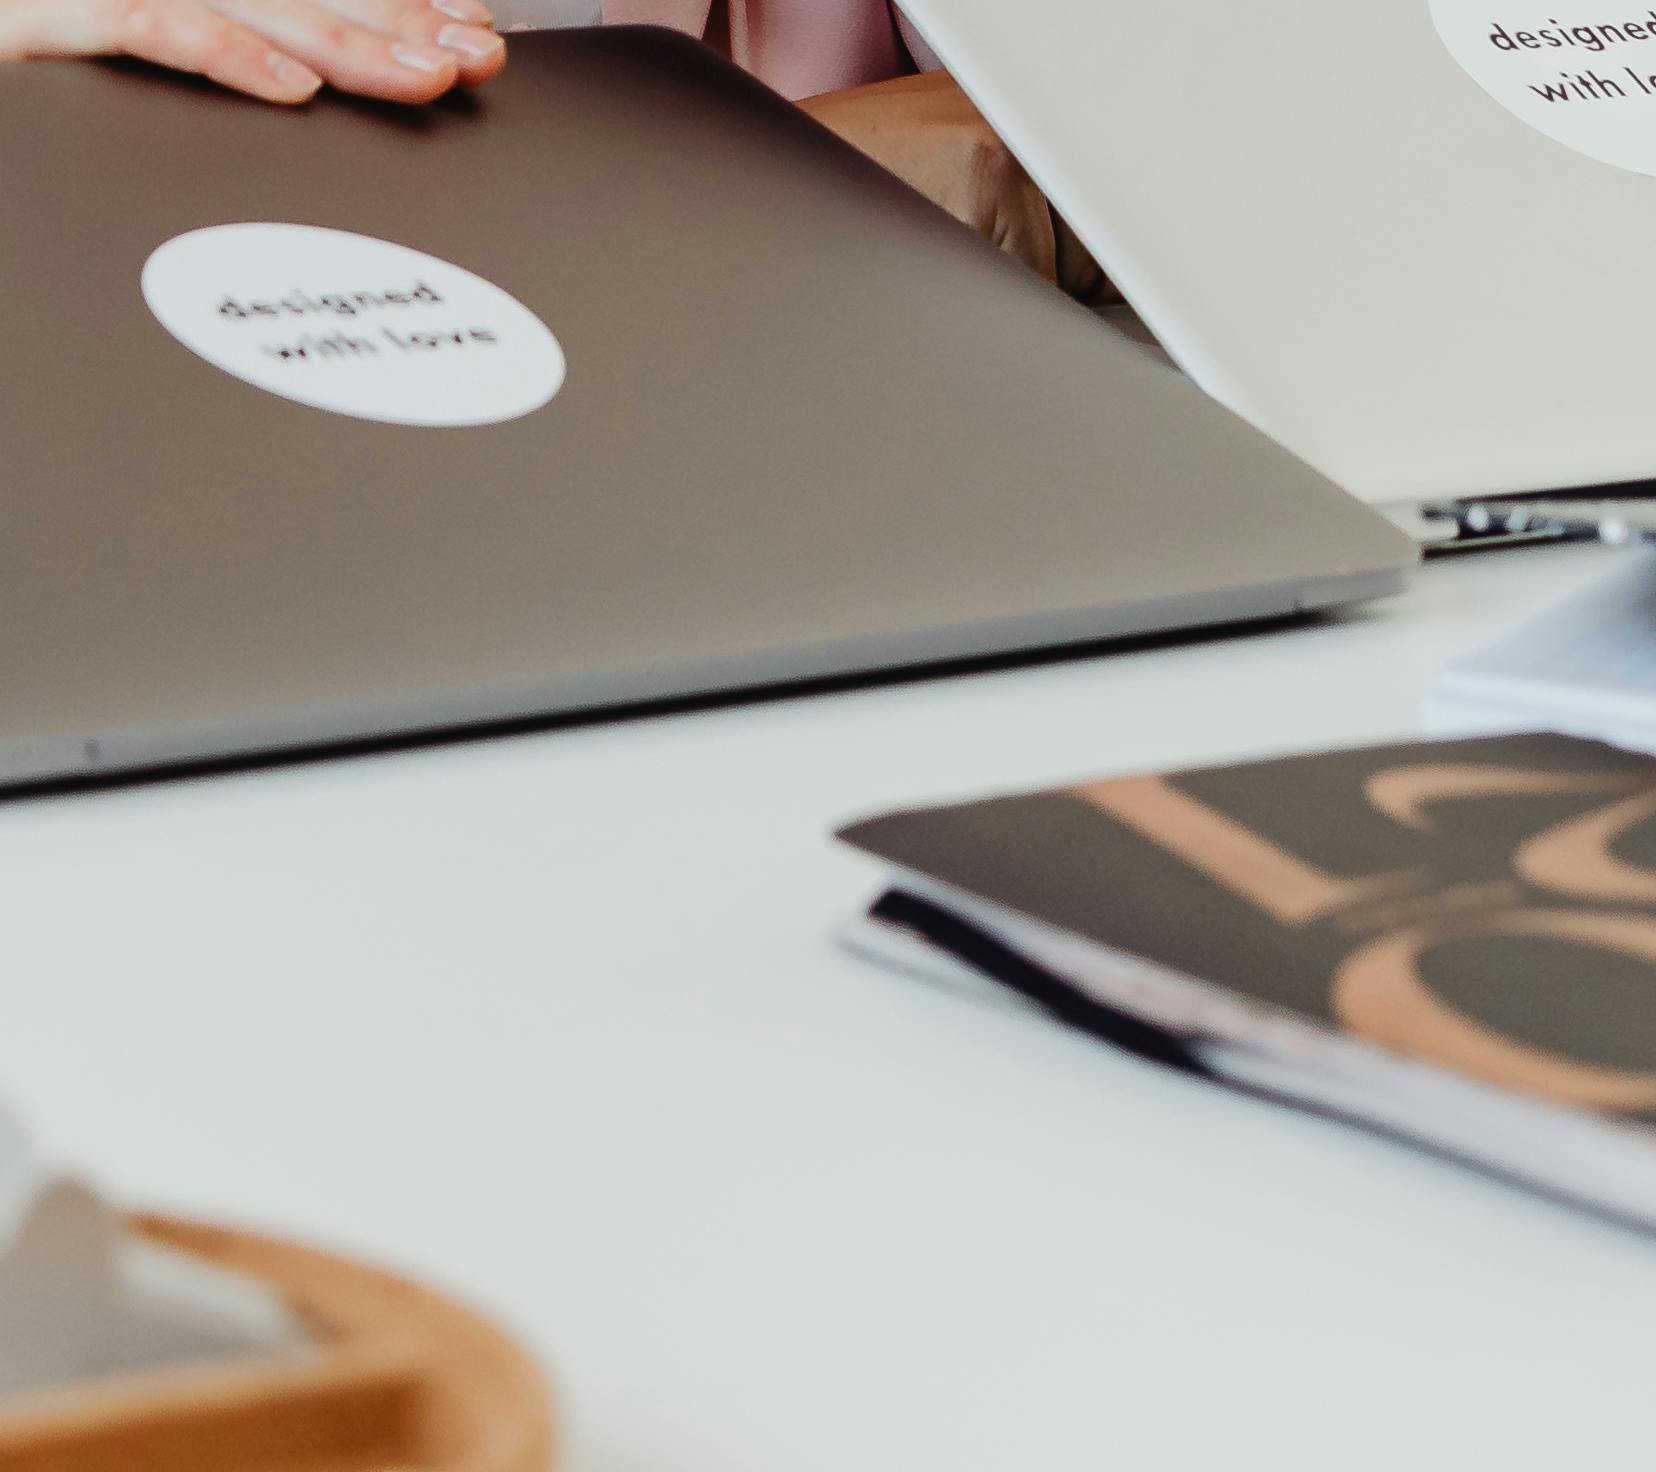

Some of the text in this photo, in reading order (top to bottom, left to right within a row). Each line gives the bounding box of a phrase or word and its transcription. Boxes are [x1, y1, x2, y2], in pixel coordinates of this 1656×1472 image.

[1528, 69, 1627, 104] with
[216, 280, 442, 319] designed
[260, 324, 500, 359] with love
